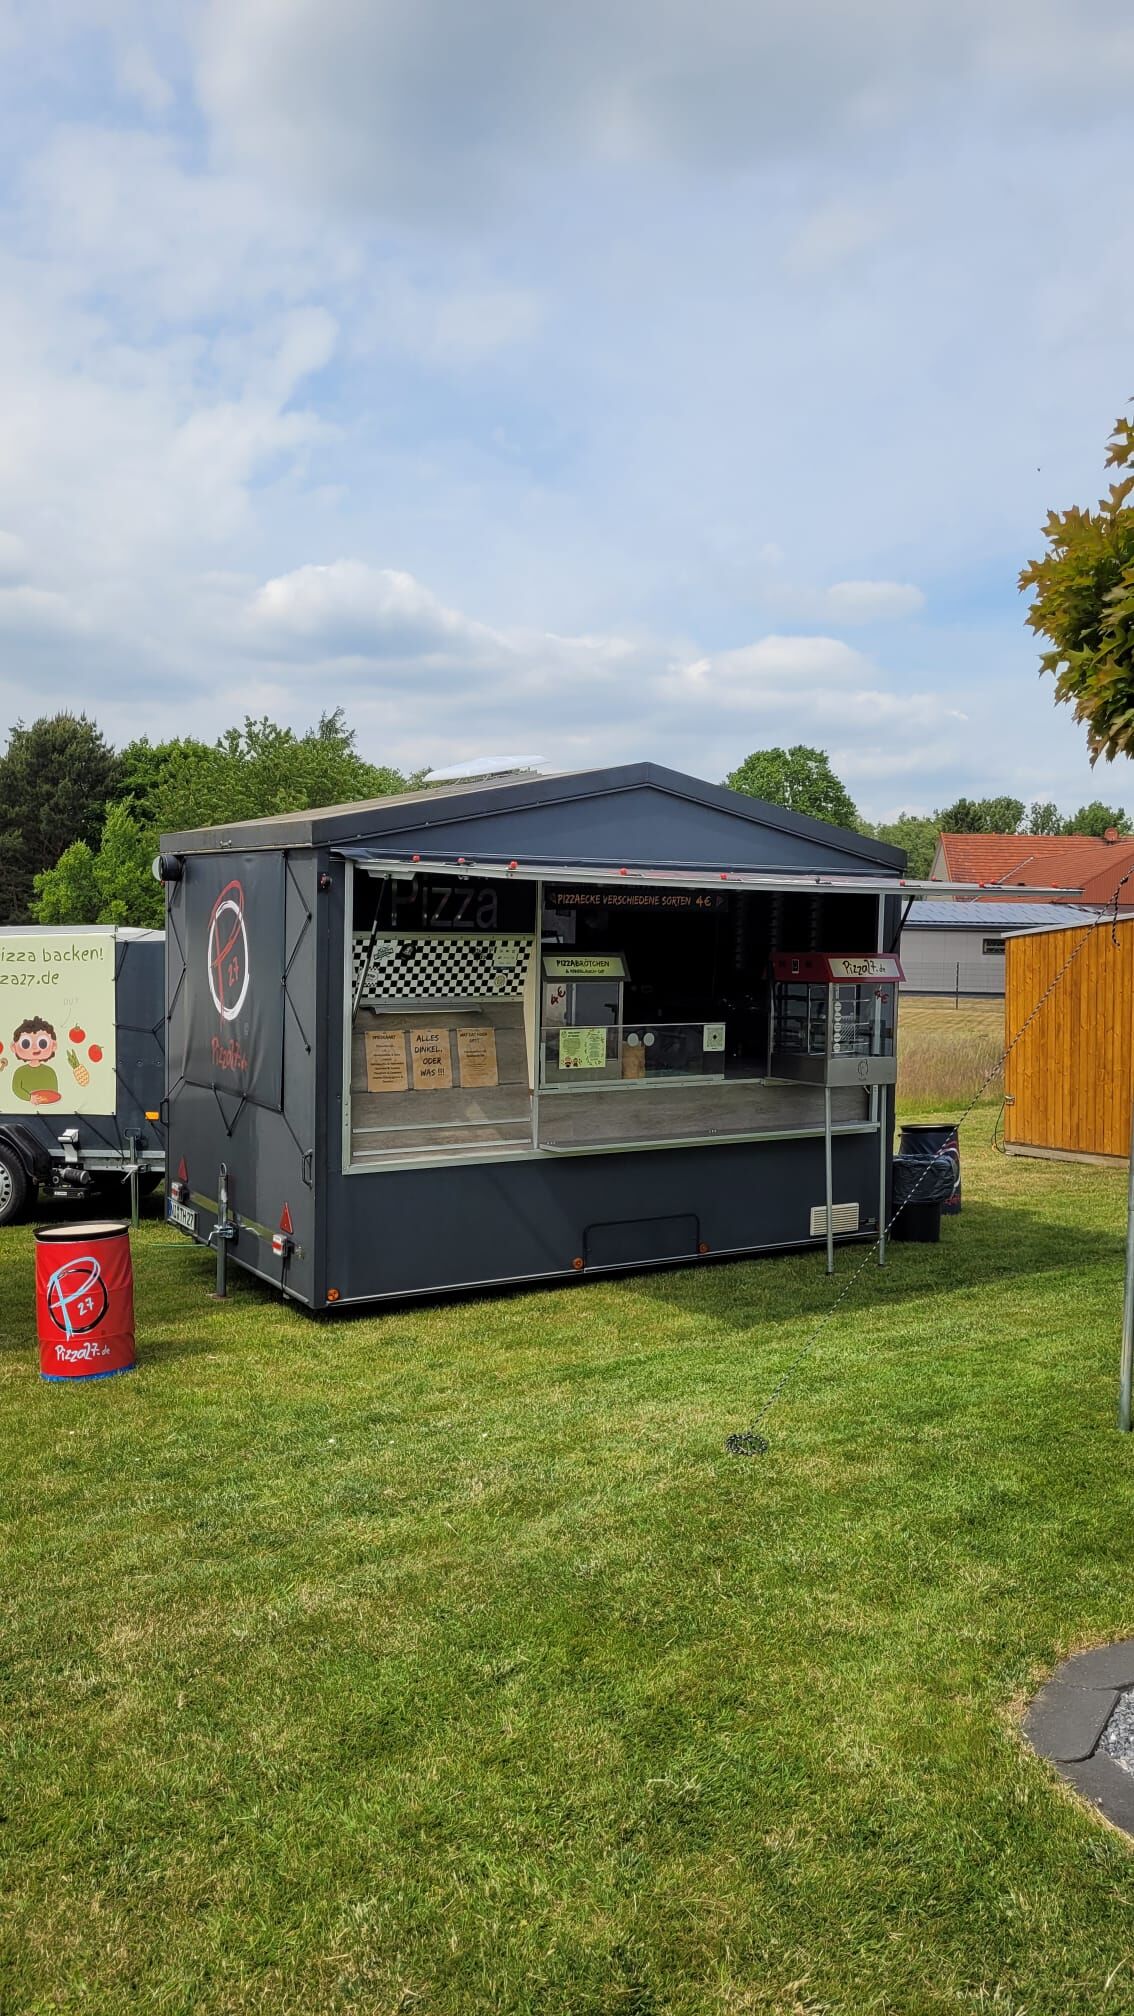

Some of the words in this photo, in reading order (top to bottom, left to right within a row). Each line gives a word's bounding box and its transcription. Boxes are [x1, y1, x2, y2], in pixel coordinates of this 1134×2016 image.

[557, 894, 601, 905] PIZZAECKE
[602, 895, 660, 906] VERSCHIEDENE
[661, 895, 692, 907] SORTEN
[42, 944, 104, 962] backen!
[556, 958, 610, 967] PIZZABRÖTCHEN
[416, 1034, 440, 1042] ALLES
[422, 1057, 441, 1065] ODER
[420, 1067, 436, 1077] WAS
[77, 1297, 94, 1316] 27
